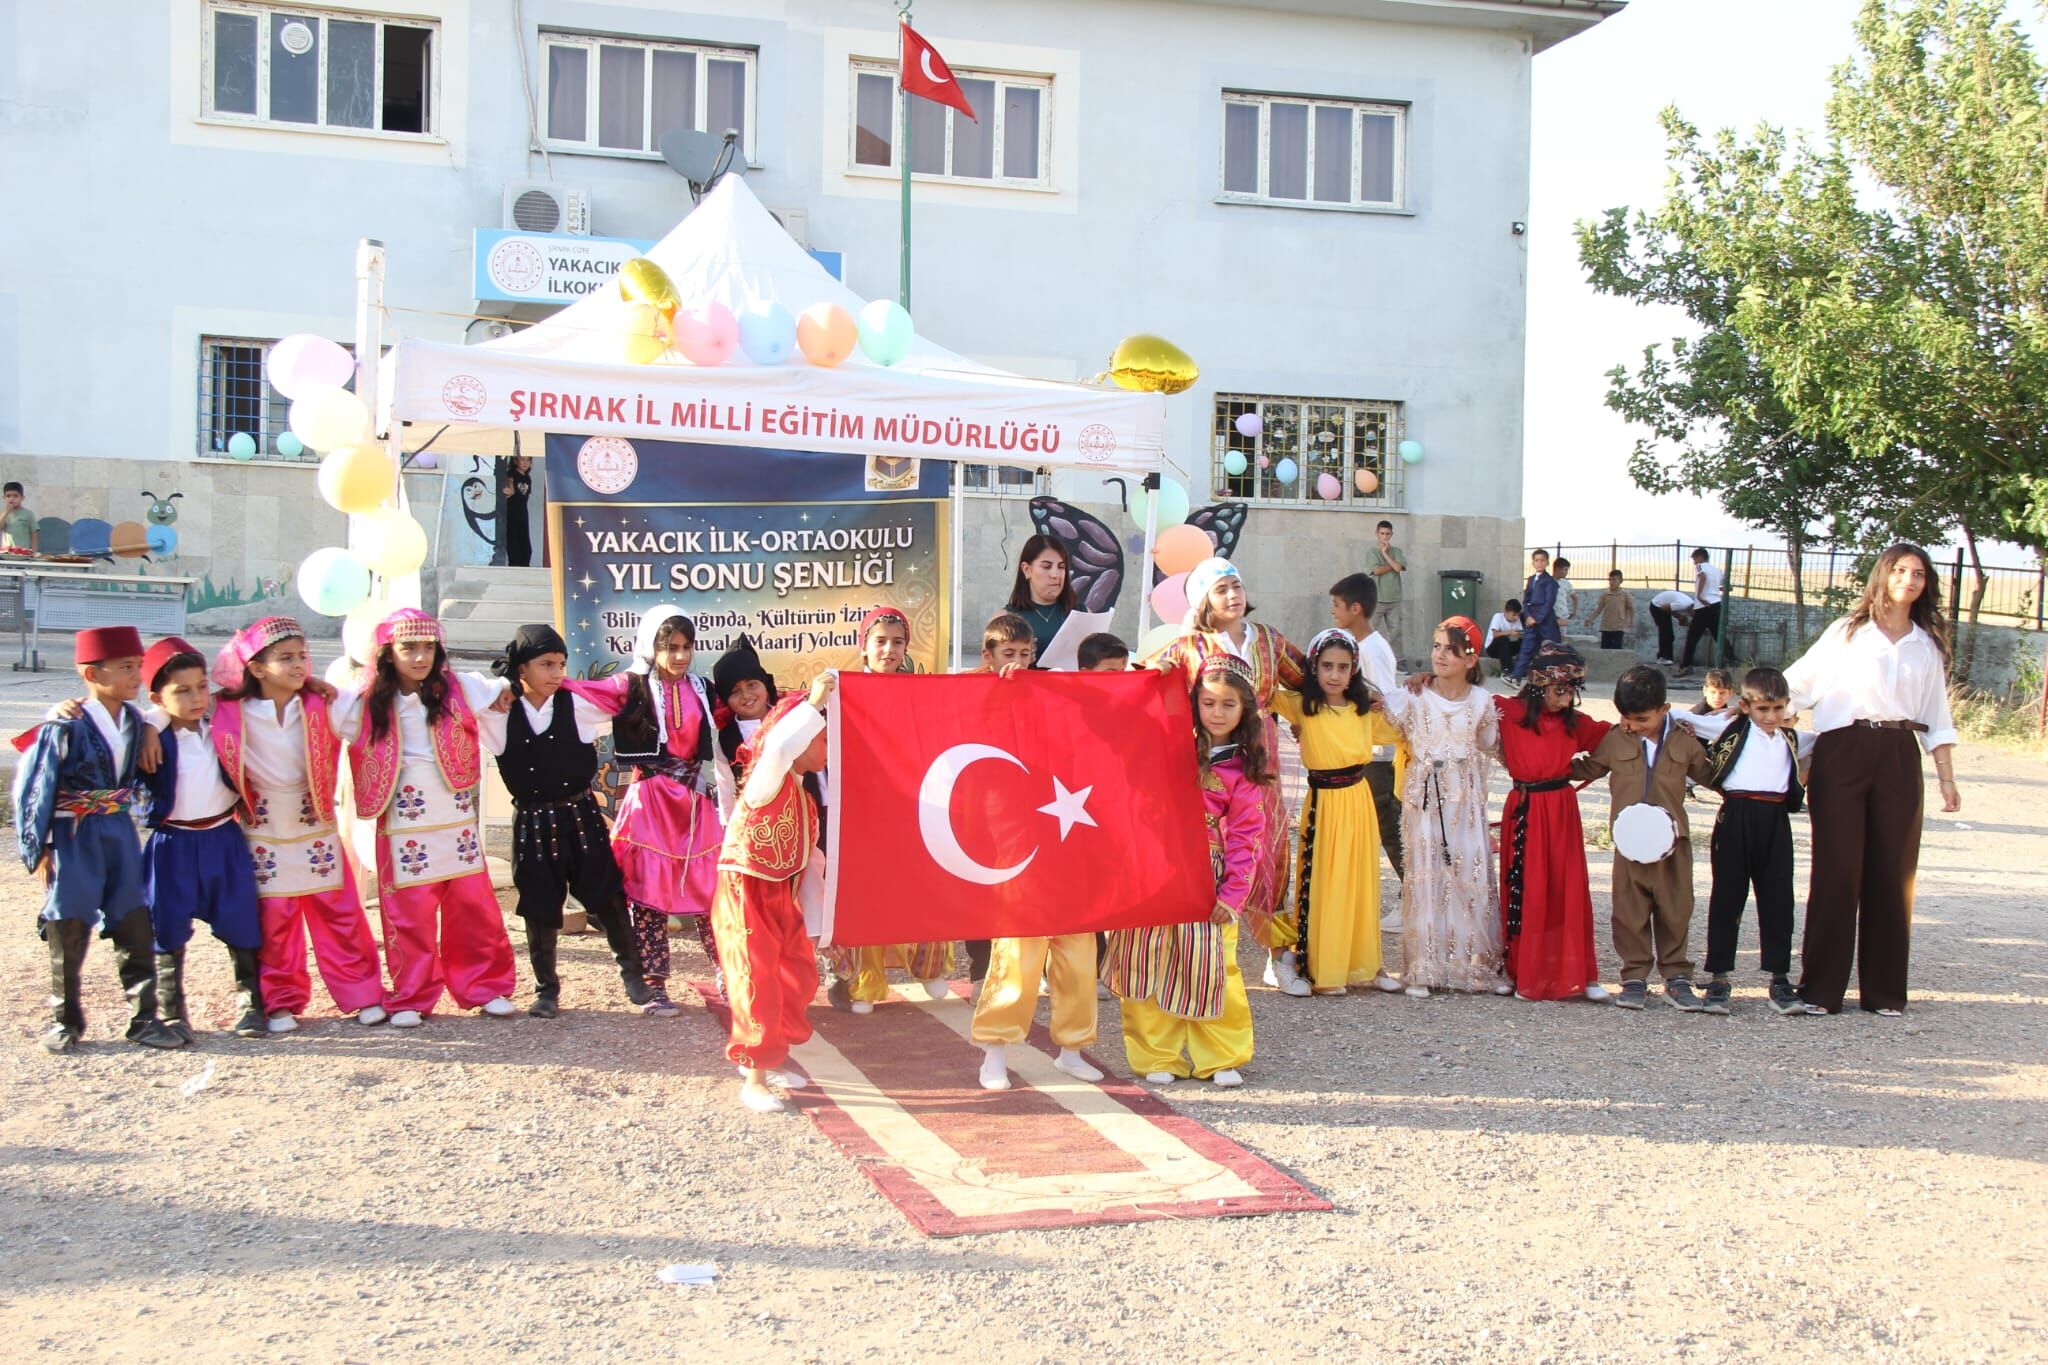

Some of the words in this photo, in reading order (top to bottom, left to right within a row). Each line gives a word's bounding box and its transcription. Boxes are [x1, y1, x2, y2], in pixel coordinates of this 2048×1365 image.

[548, 257, 621, 274] YAKACIK
[548, 276, 604, 295] İLKOK
[509, 389, 627, 423] ŞIRNAK
[635, 393, 661, 425] İL
[671, 398, 752, 432] MİLLİ
[761, 404, 864, 439] EĞİTİM
[873, 412, 1061, 454] MÜDÜRLÜĞÜ
[585, 530, 702, 554] YAKACIK
[709, 526, 914, 552] İLK-ORTAOKULU
[606, 562, 661, 591] YIL
[670, 562, 764, 590] SONU
[773, 552, 895, 595] ŞENLİĞİ
[756, 609, 836, 629] Kültürün
[748, 632, 806, 653] Maarif
[807, 630, 862, 653] Yolcul
